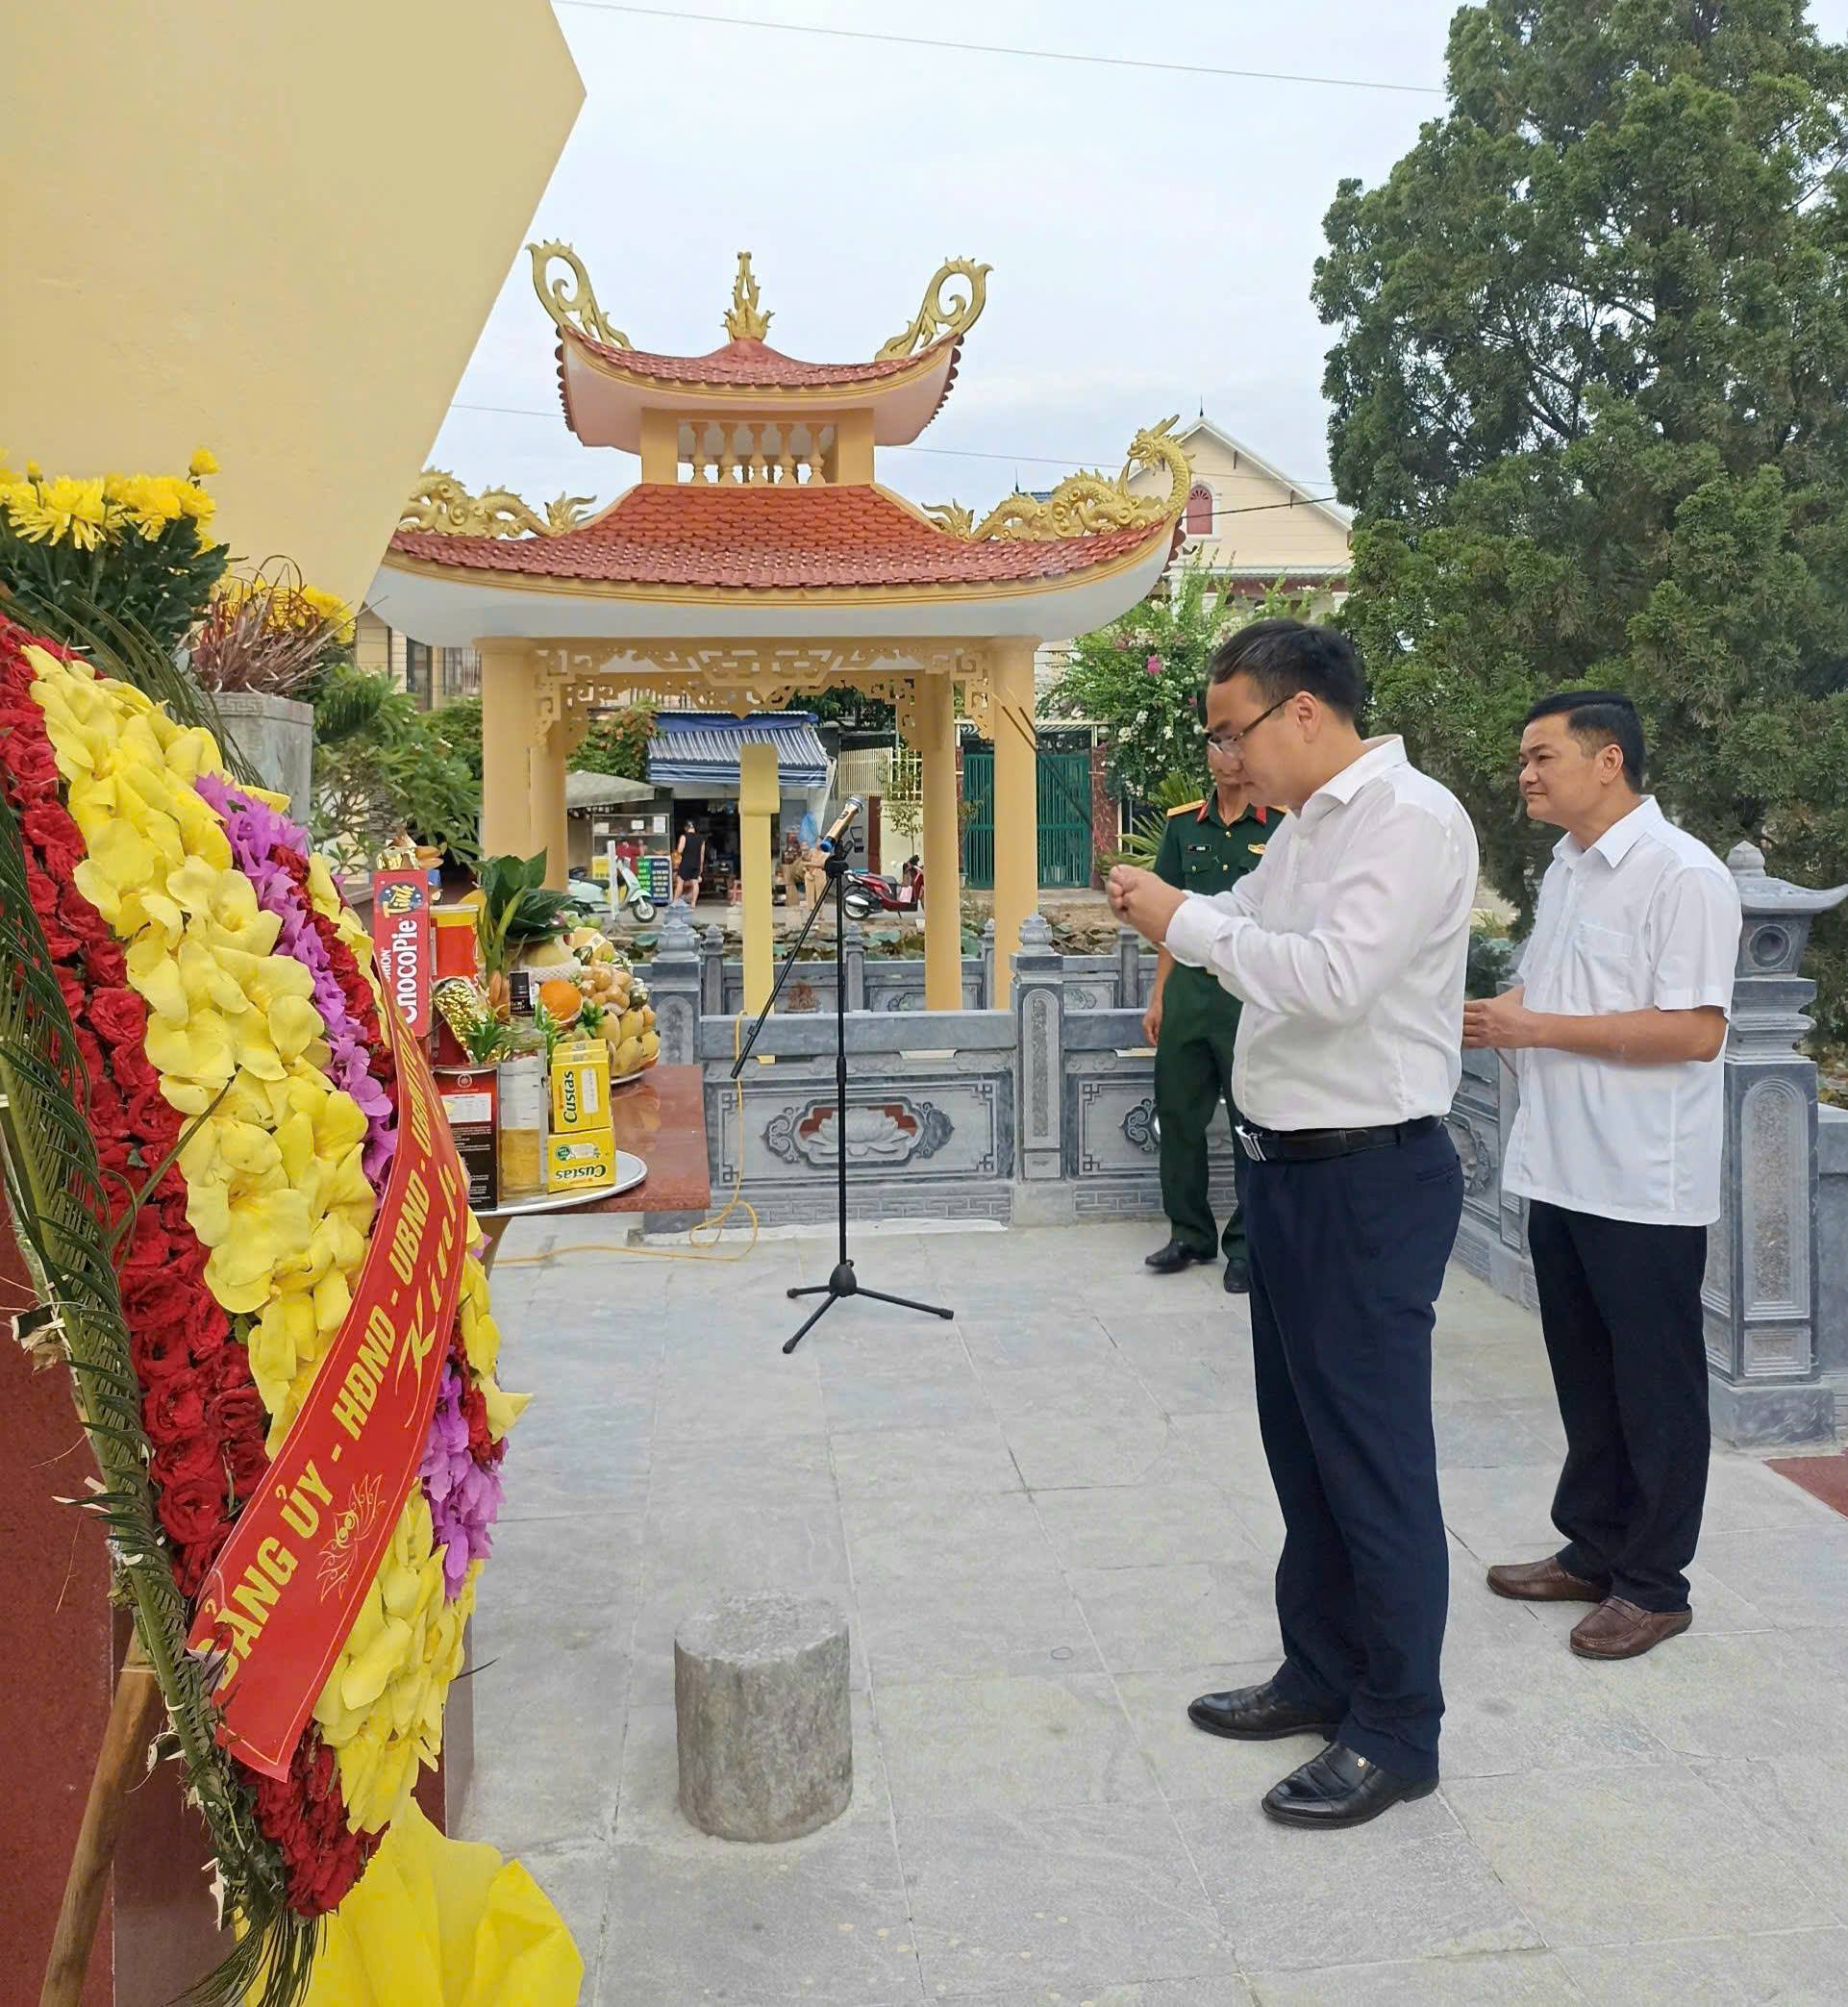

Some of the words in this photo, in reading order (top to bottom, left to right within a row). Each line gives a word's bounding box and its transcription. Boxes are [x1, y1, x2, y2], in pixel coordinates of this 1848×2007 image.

[563, 1070, 578, 1123] Custas
[556, 1164, 607, 1180] Custas
[275, 1459, 334, 1539] ỦY
[332, 1305, 396, 1441] HĐND
[389, 1169, 430, 1285] UBND
